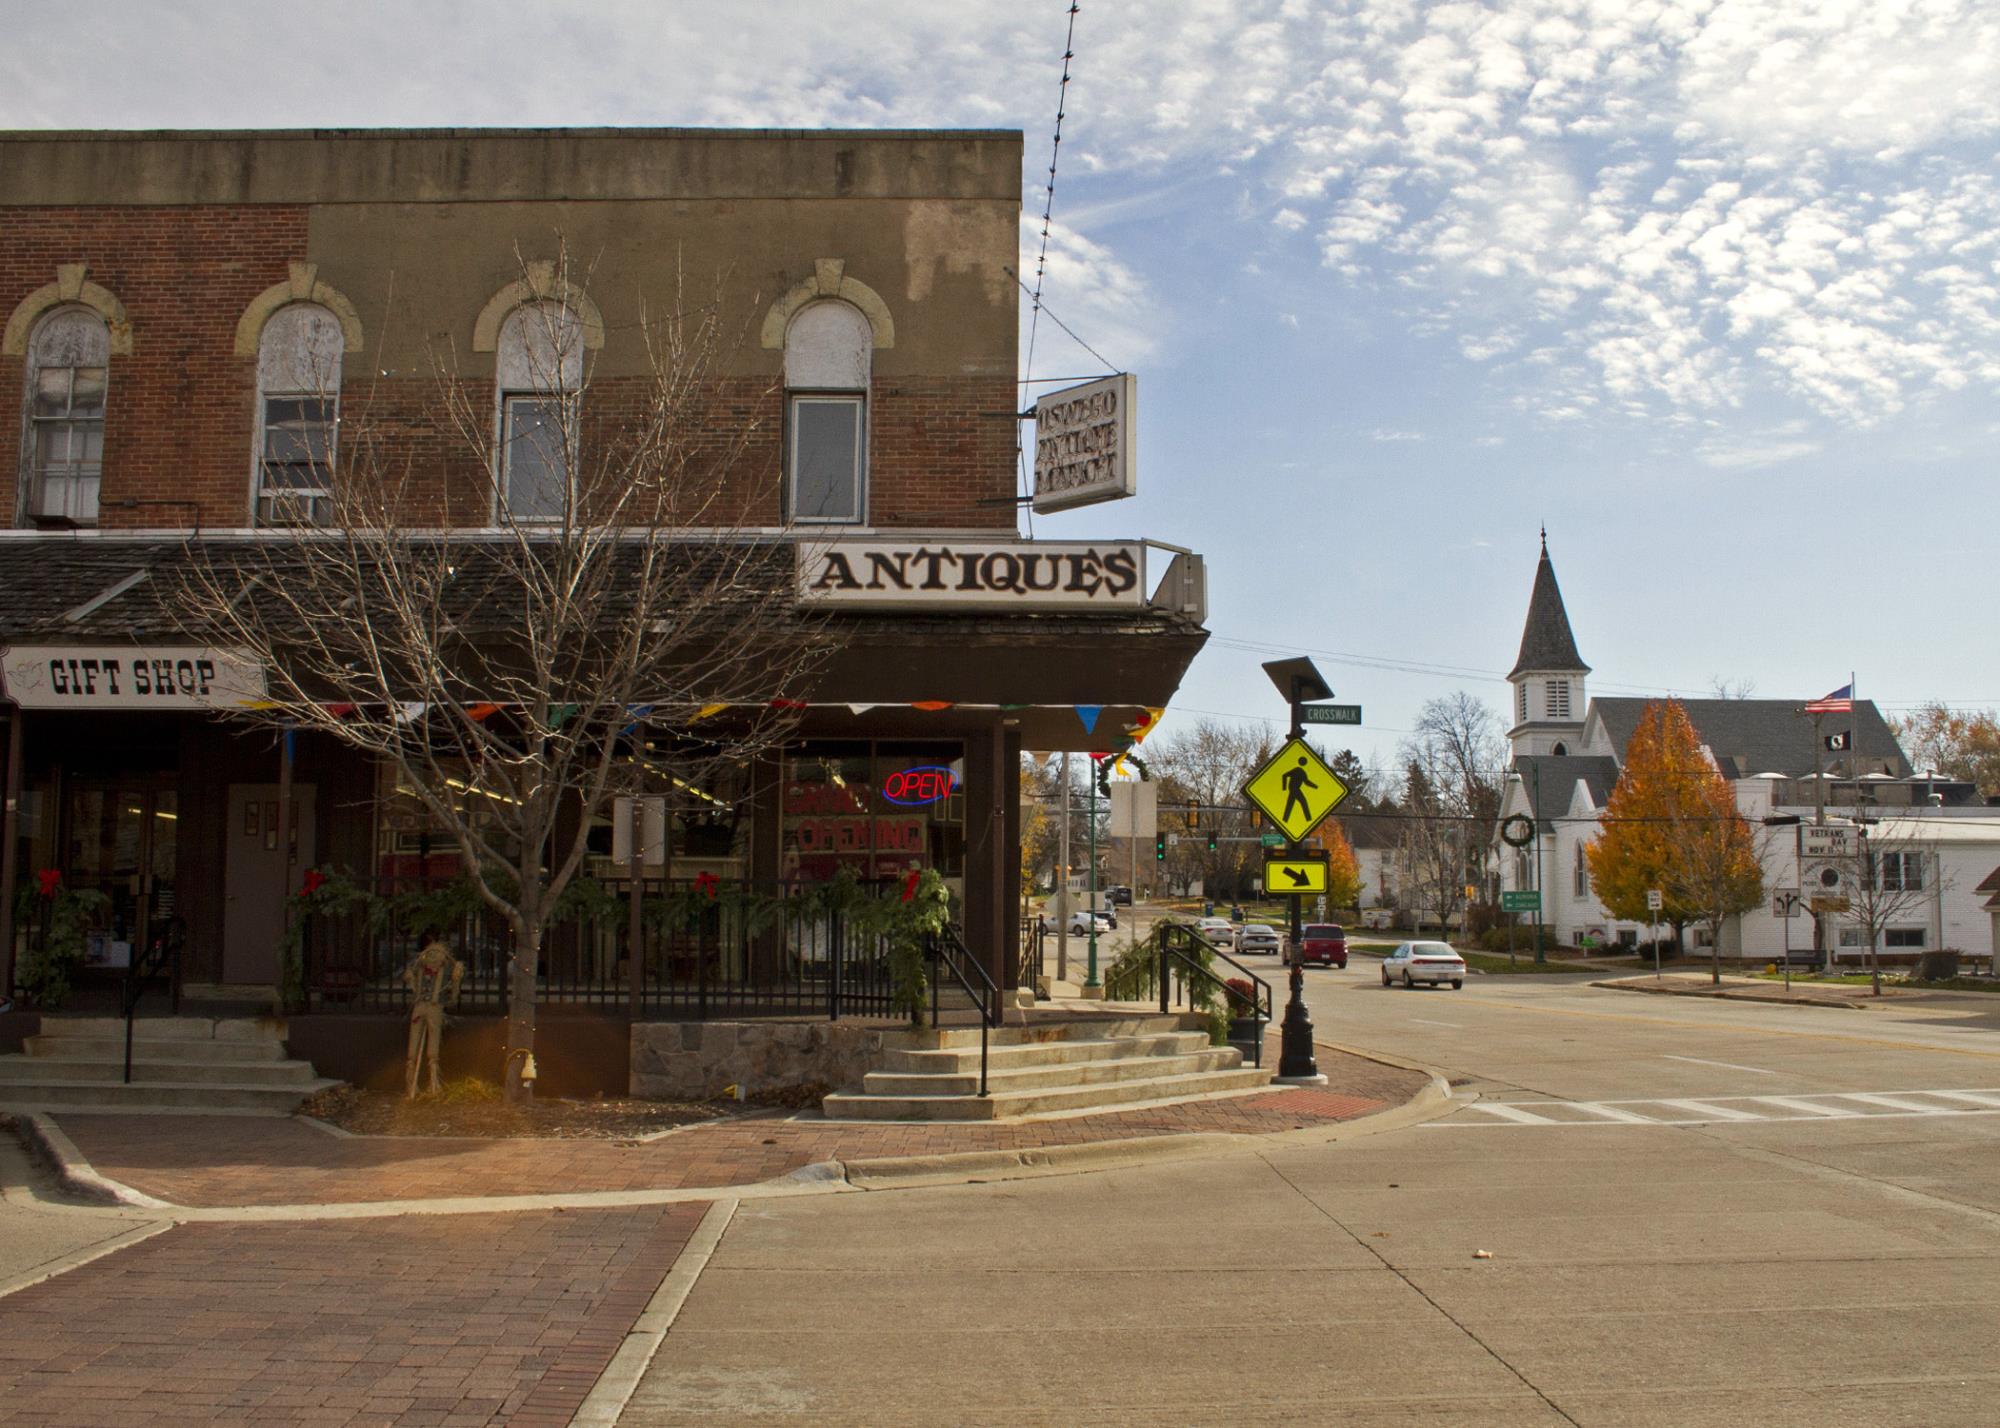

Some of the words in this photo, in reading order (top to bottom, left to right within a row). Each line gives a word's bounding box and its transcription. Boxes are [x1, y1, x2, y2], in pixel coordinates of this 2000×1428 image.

[1036, 420, 1118, 466] ANTIQUE
[810, 547, 1137, 597] ANTIQUES
[50, 659, 121, 695] GIFT
[133, 659, 216, 696] SHOP
[1307, 708, 1357, 720] CROSSWALK
[885, 771, 953, 800] OPEN
[799, 818, 923, 852] OPENING
